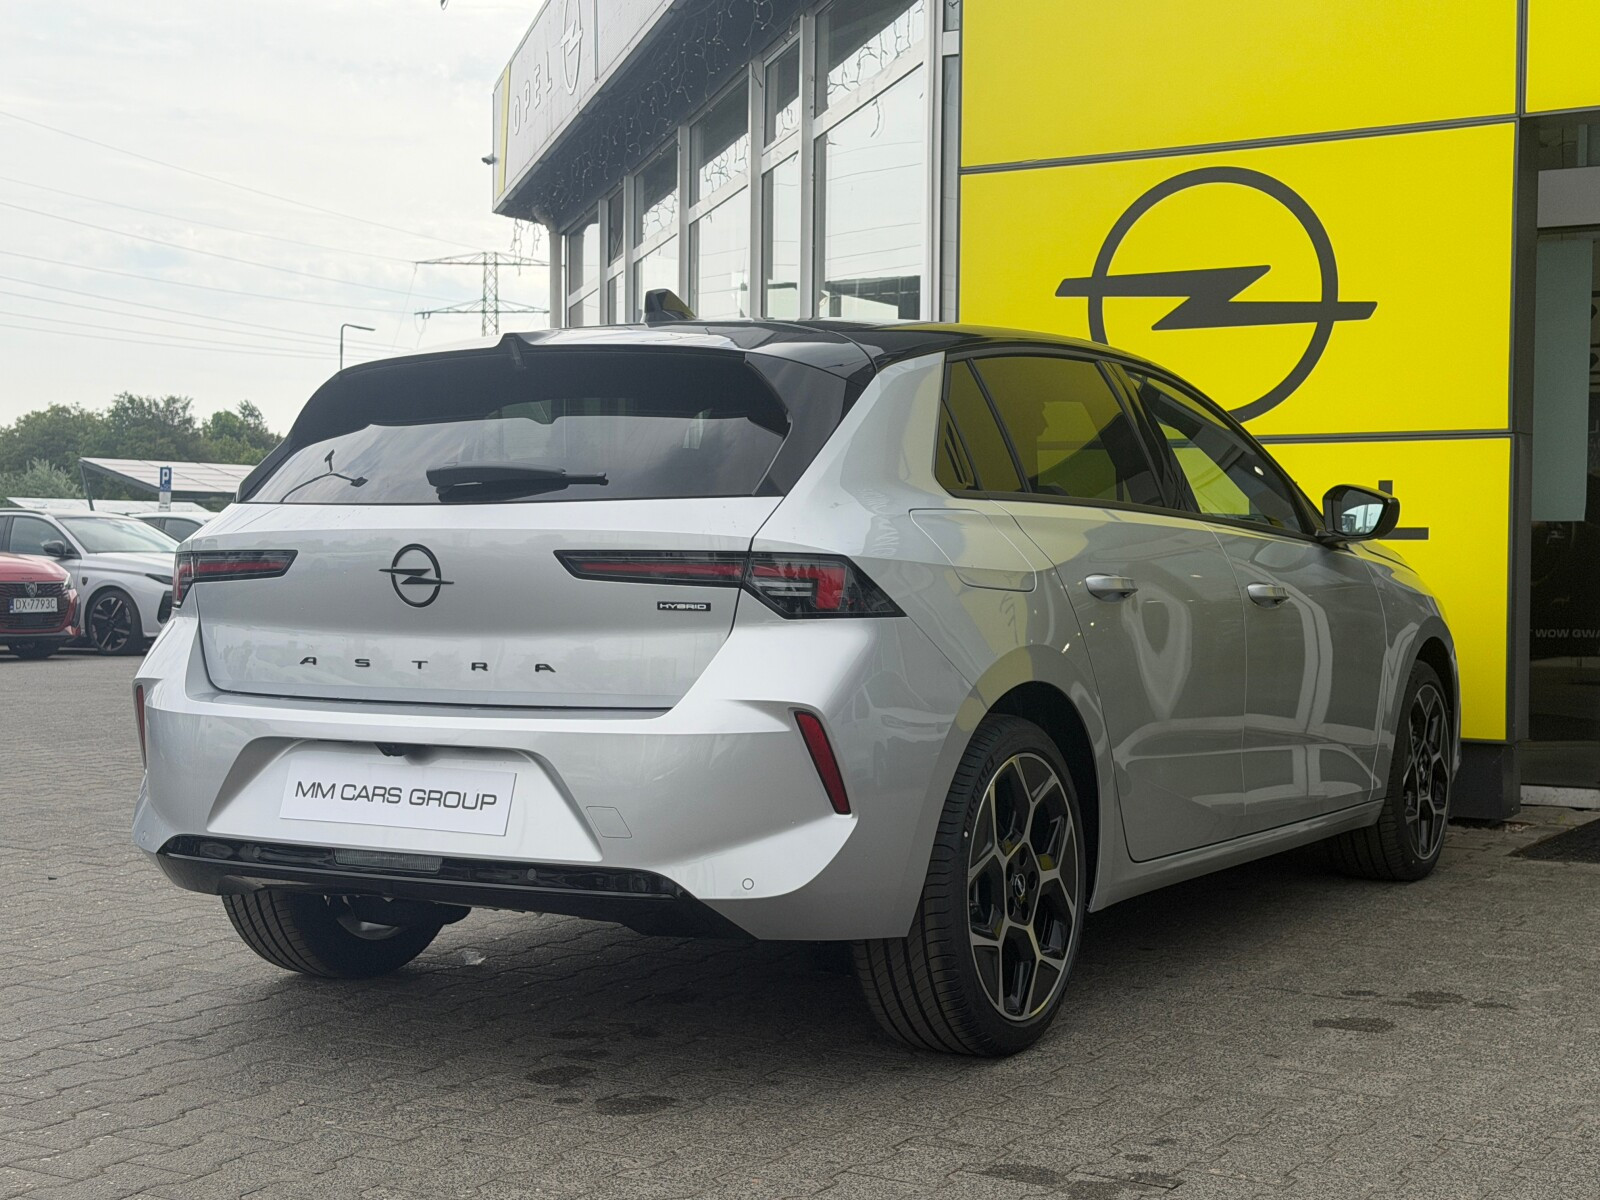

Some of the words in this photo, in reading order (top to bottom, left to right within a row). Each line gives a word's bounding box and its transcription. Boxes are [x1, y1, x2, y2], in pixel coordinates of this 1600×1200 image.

[514, 51, 552, 136] OPEL
[162, 469, 170, 485] P
[15, 599, 27, 610] DX
[30, 599, 56, 610] 7793C
[1535, 628, 1569, 638] WOW
[300, 656, 556, 673] ASTRA
[295, 781, 336, 800] MM
[340, 784, 403, 804] CARS
[408, 788, 498, 811] GROUP
